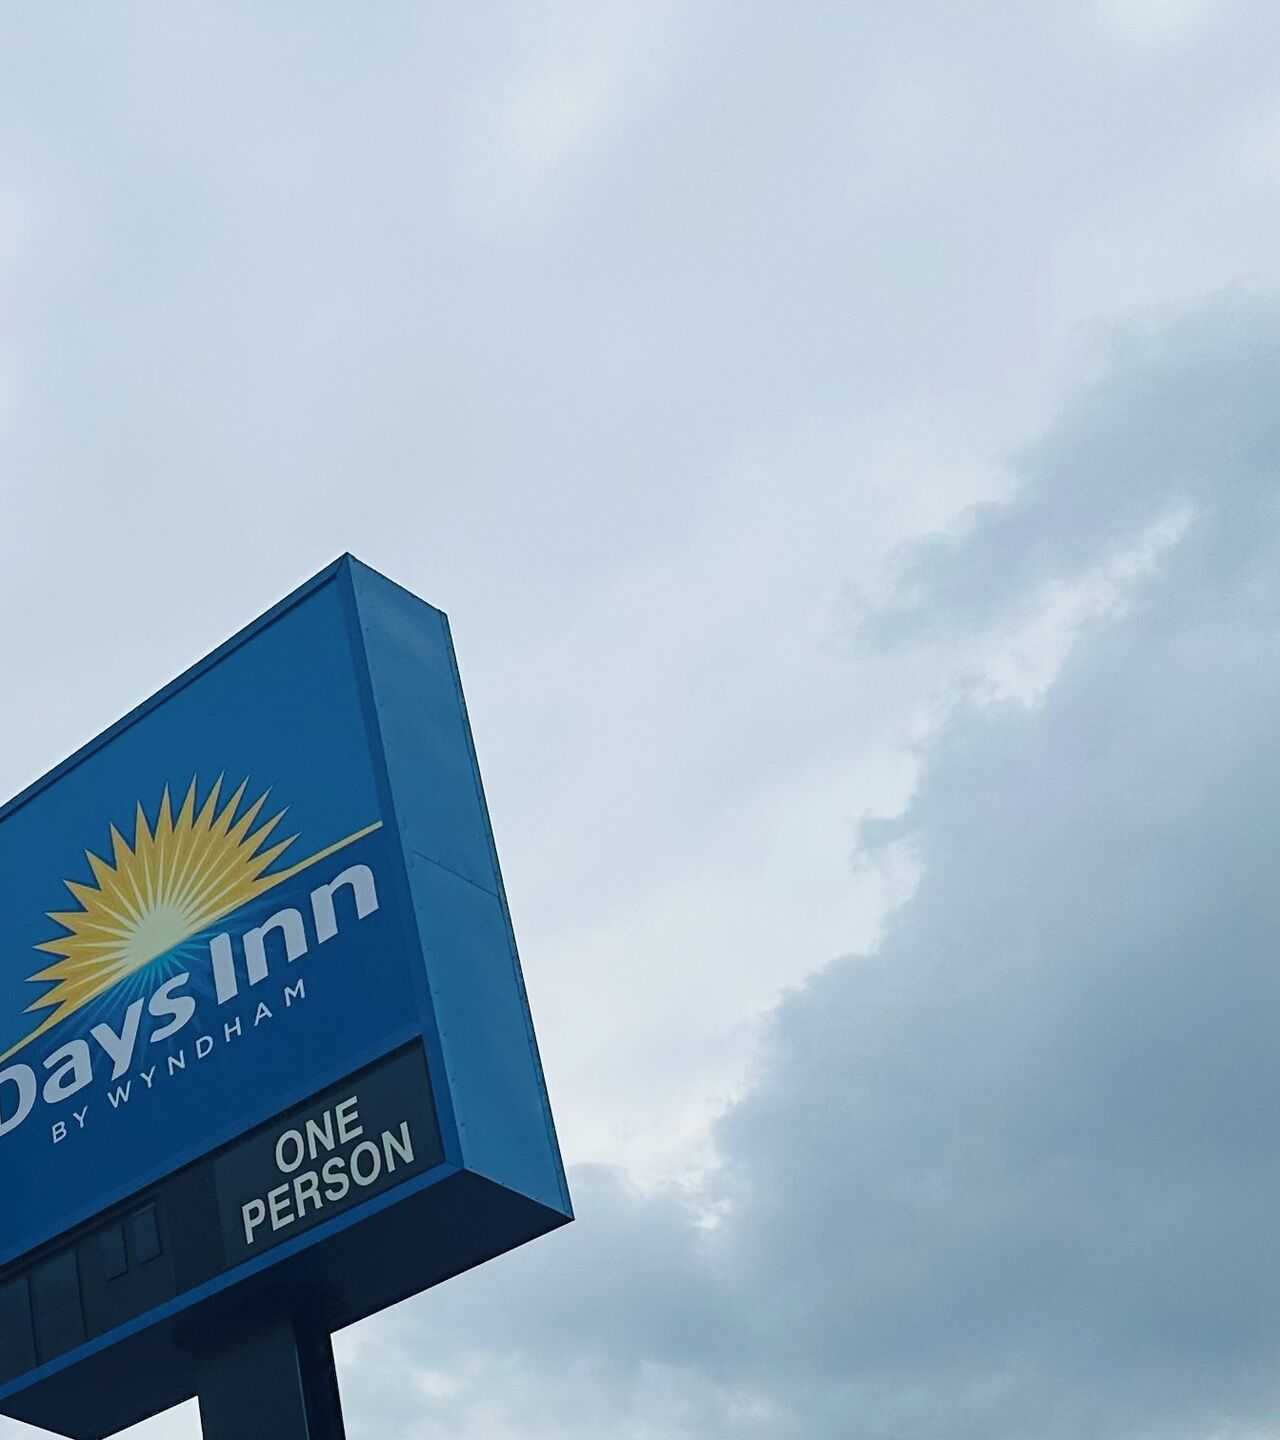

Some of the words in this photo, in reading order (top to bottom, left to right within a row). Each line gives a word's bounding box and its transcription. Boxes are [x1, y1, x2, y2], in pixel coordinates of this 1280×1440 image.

[209, 864, 380, 1005] Inn
[52, 1106, 89, 1144] BY
[107, 979, 306, 1109] WYNDHAM
[241, 1121, 415, 1245] PERSON
[275, 1095, 365, 1174] ONE
